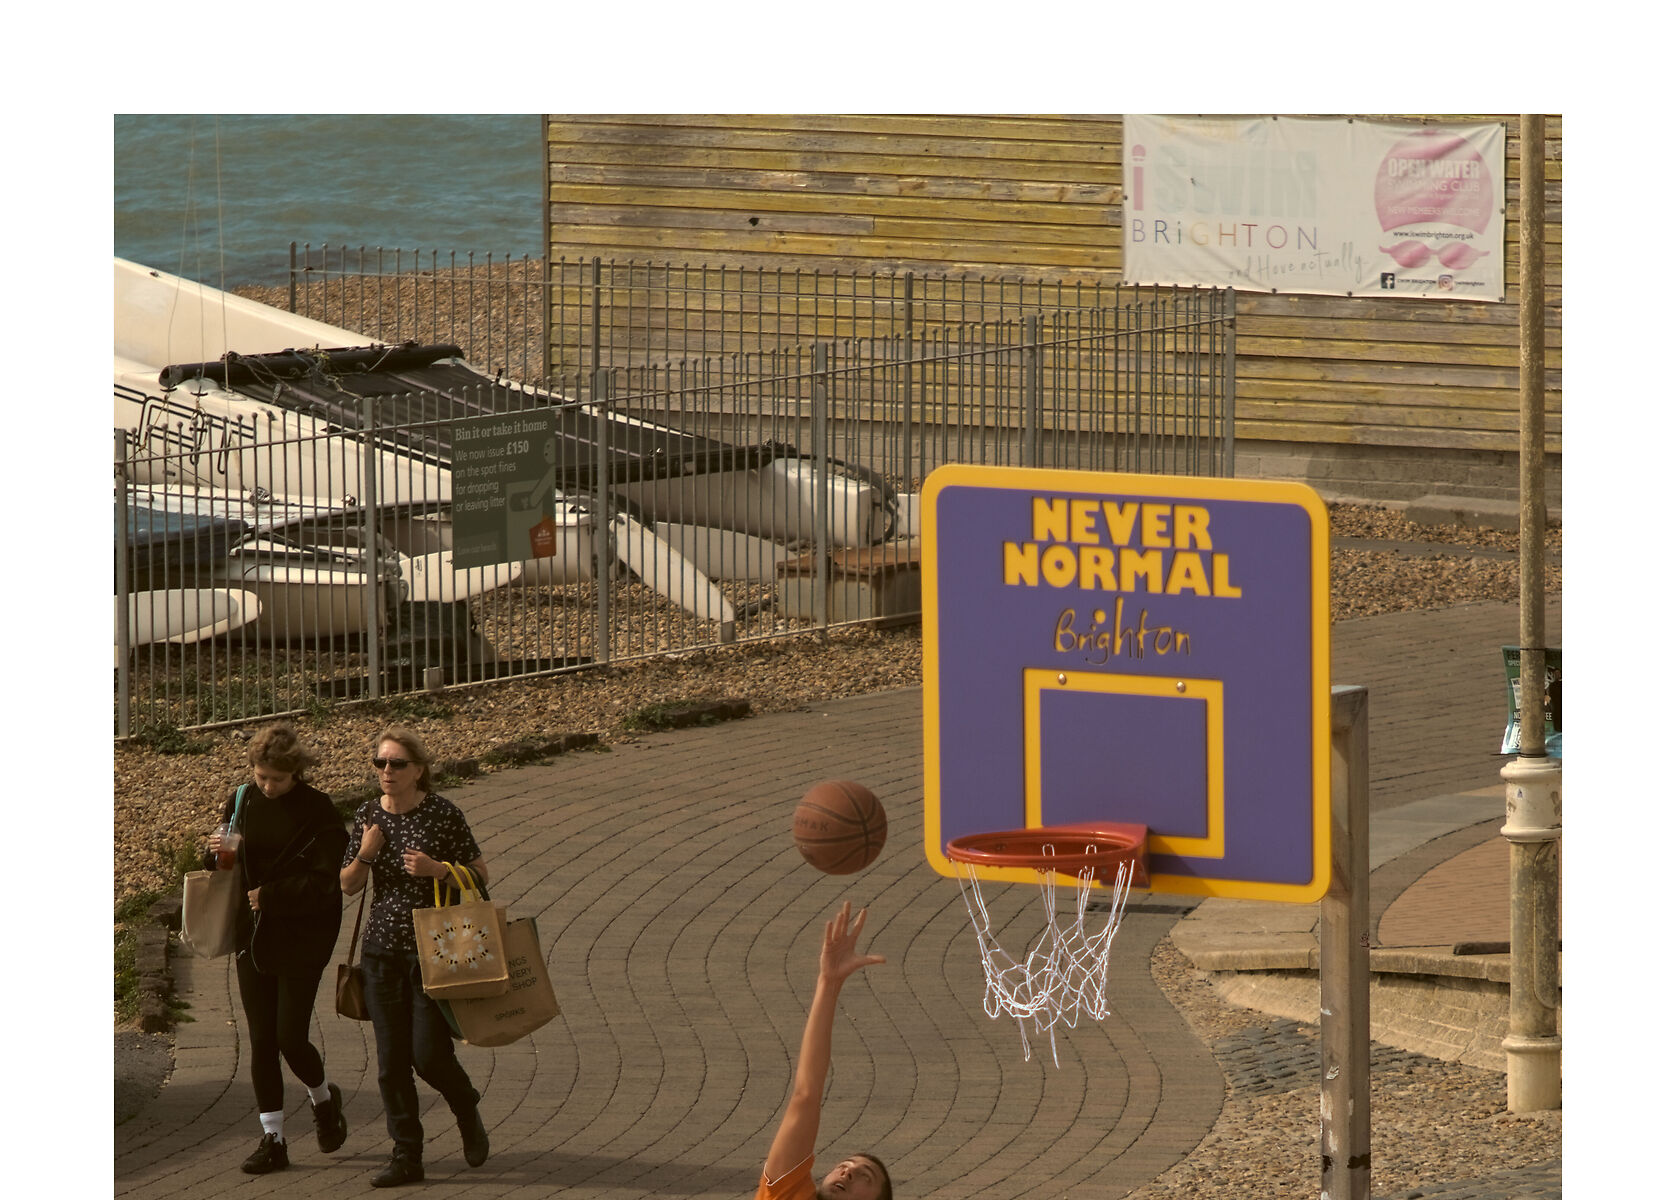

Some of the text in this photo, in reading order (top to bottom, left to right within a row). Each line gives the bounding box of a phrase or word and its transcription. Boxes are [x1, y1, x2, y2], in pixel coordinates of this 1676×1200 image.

[1387, 157, 1480, 179] OPEN WATER
[1450, 180, 1480, 193] CLUB
[455, 419, 548, 441] Bin it or take it home
[455, 440, 529, 461] We now issue £150
[456, 460, 517, 479] on the spot fines
[455, 480, 499, 496] for dropping
[455, 495, 506, 512] or leaving litter
[1032, 496, 1213, 551] NEVER
[1003, 541, 1243, 599] NORMAL
[1053, 596, 1192, 667] Brighton
[510, 967, 533, 980] VERY
[512, 977, 538, 992] SHOP
